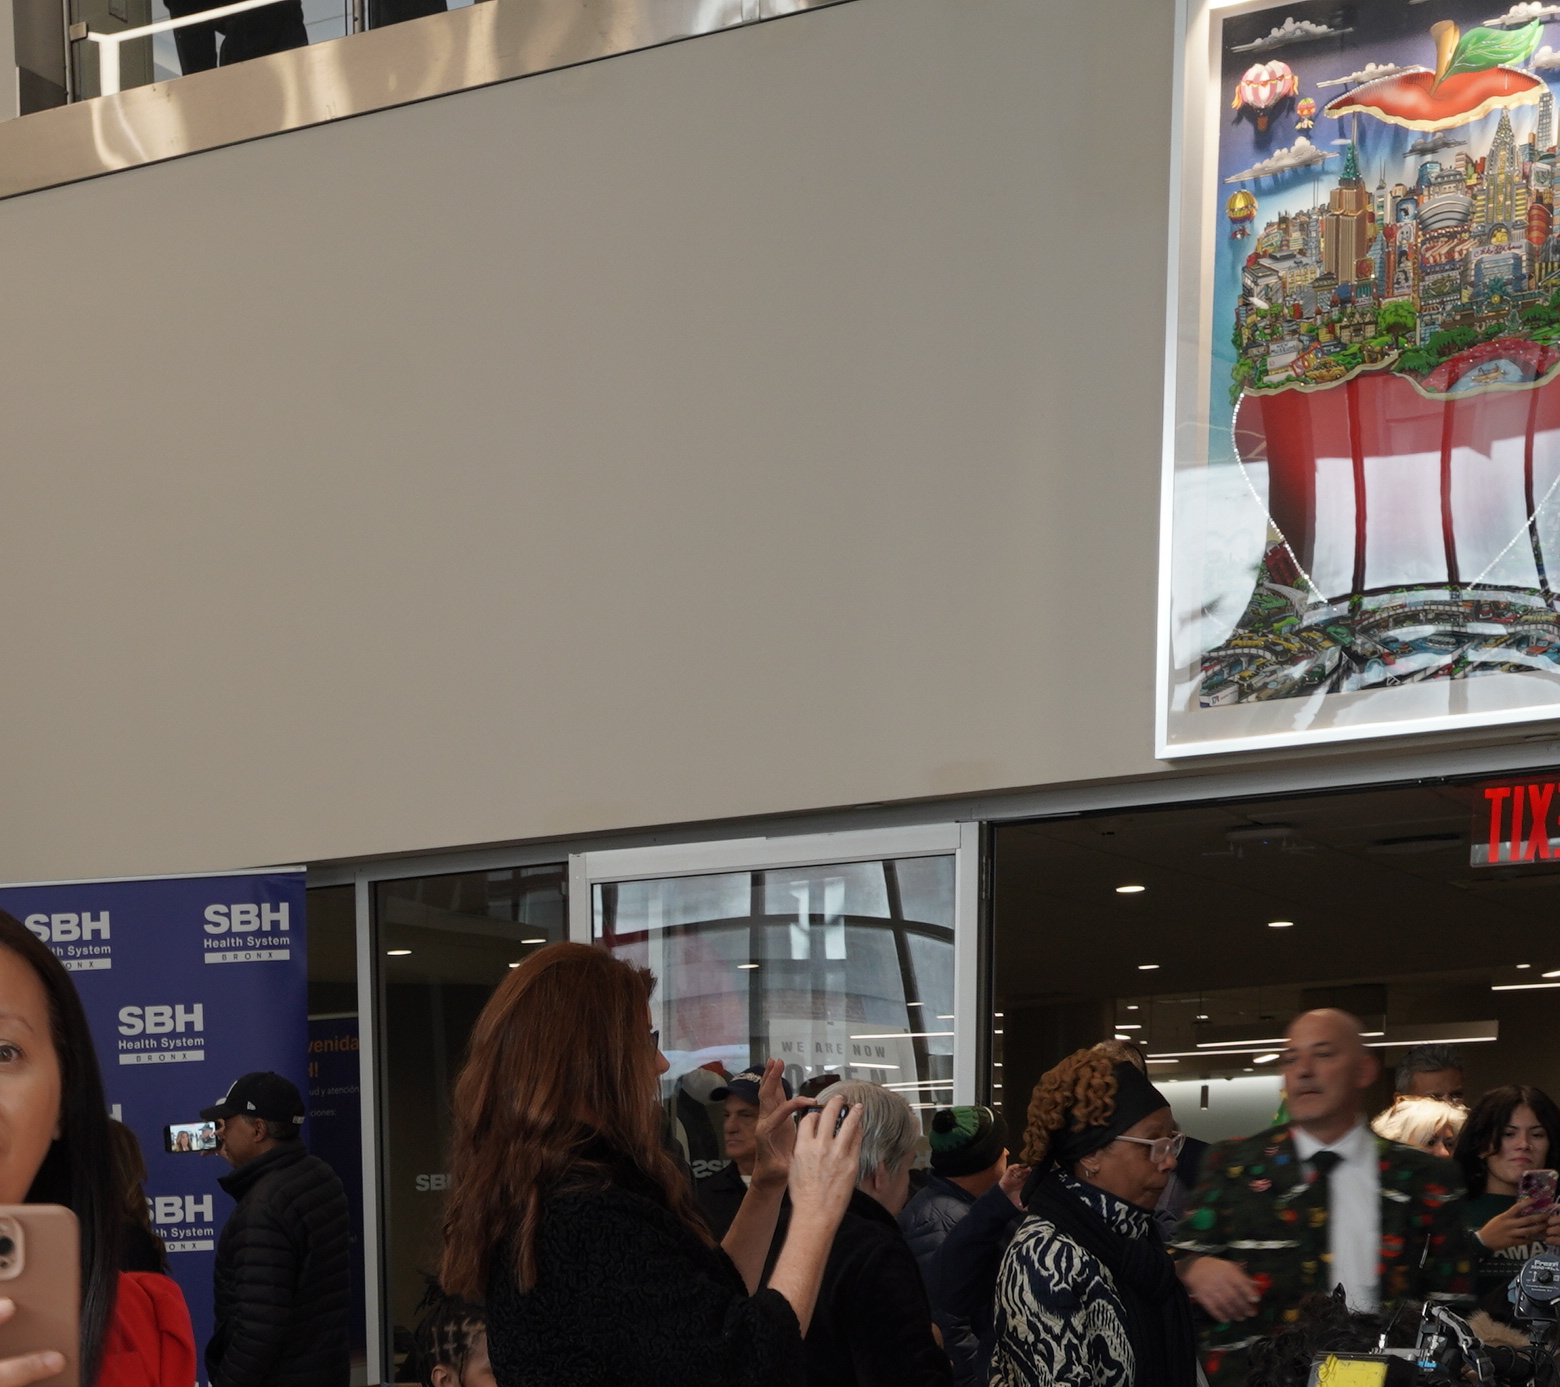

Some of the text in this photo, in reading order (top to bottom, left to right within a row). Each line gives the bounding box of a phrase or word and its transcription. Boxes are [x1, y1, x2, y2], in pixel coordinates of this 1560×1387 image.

[204, 902, 290, 934] SBH
[25, 911, 111, 943] SBH
[204, 934, 290, 949] Health System
[67, 944, 111, 958] System
[221, 951, 274, 962] BRONX
[65, 959, 95, 970] ONX
[118, 1003, 204, 1036] SBH
[118, 1035, 205, 1050] Health System
[782, 1041, 886, 1059] WE ARE NOW
[135, 1053, 189, 1063] BRONX
[171, 1226, 214, 1239] System
[168, 1242, 197, 1251] ONX
